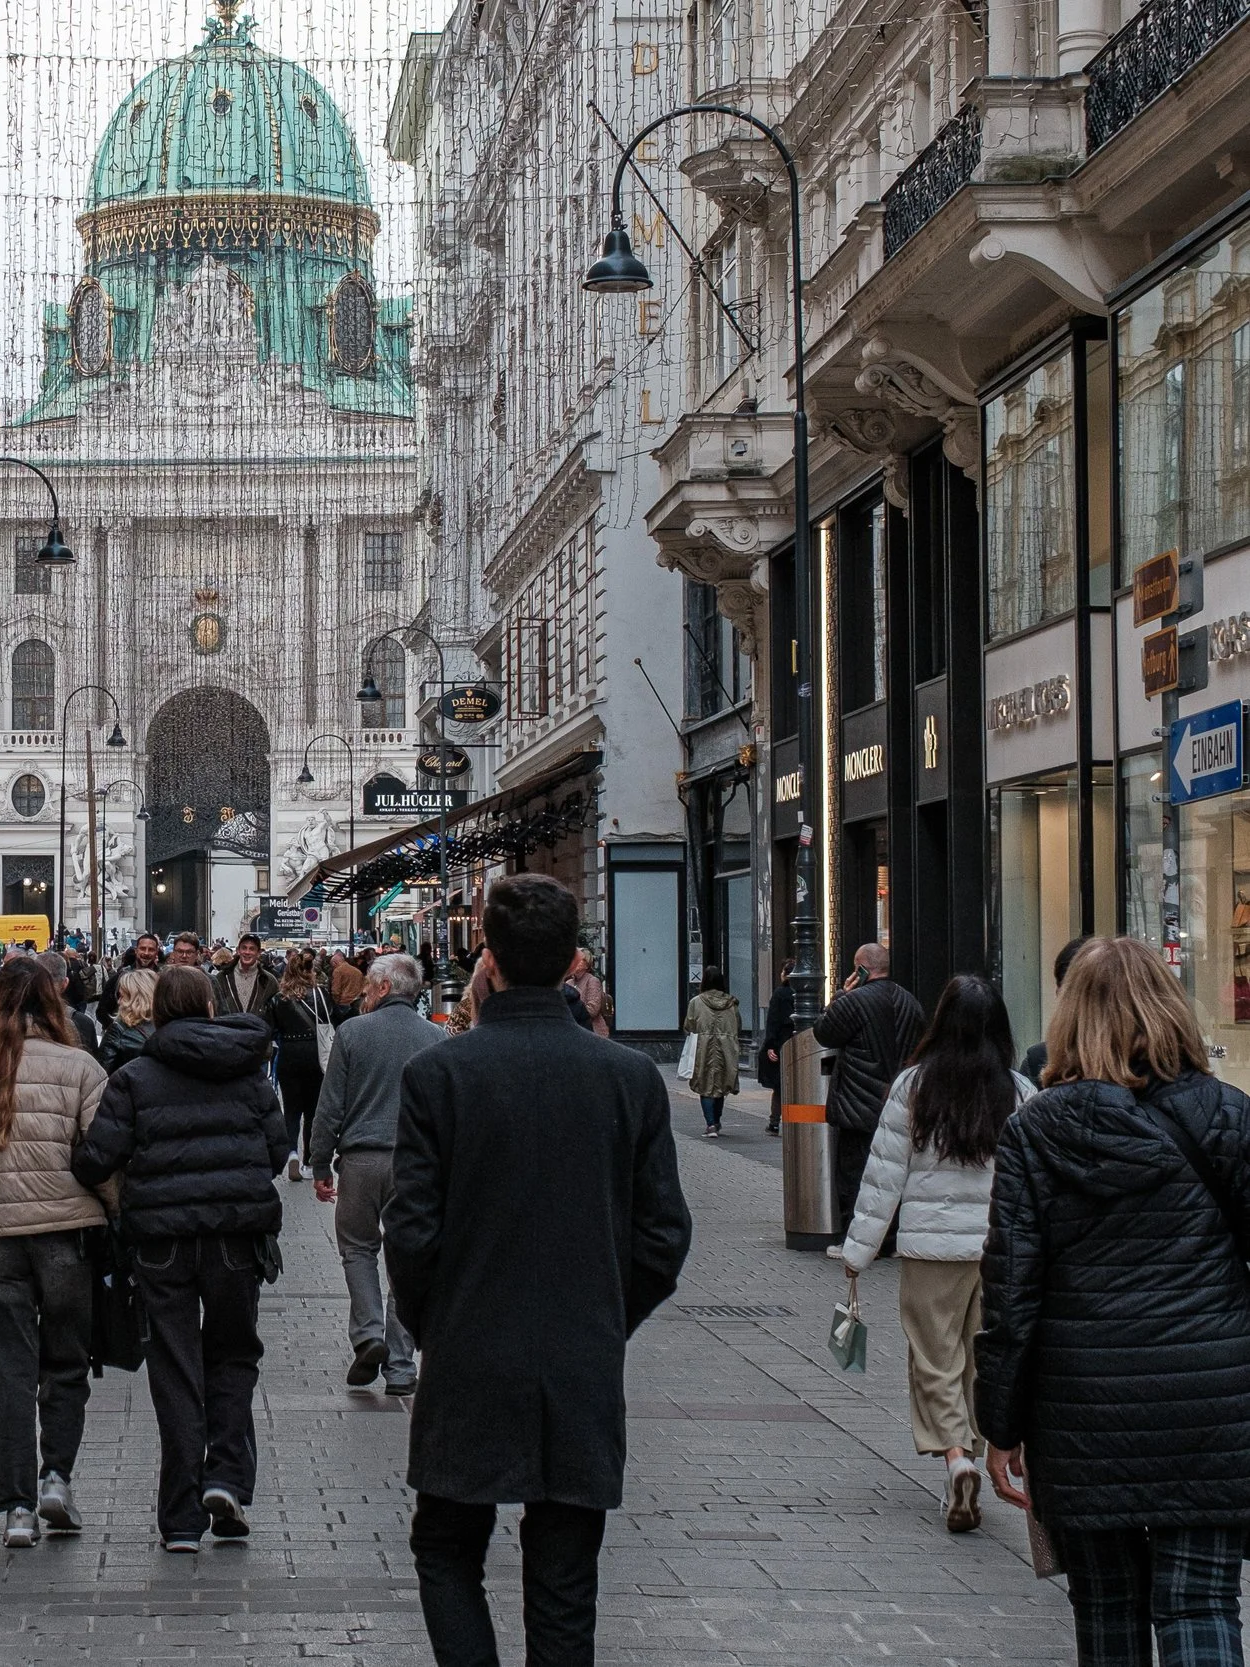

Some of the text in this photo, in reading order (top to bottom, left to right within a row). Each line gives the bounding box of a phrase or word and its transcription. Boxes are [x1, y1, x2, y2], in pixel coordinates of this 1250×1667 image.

[451, 697, 488, 707] DEMEL
[422, 755, 465, 770] Choard
[844, 744, 884, 782] MONCLER
[1192, 729, 1233, 774] EINBAHN
[776, 771, 800, 802] MONCLE
